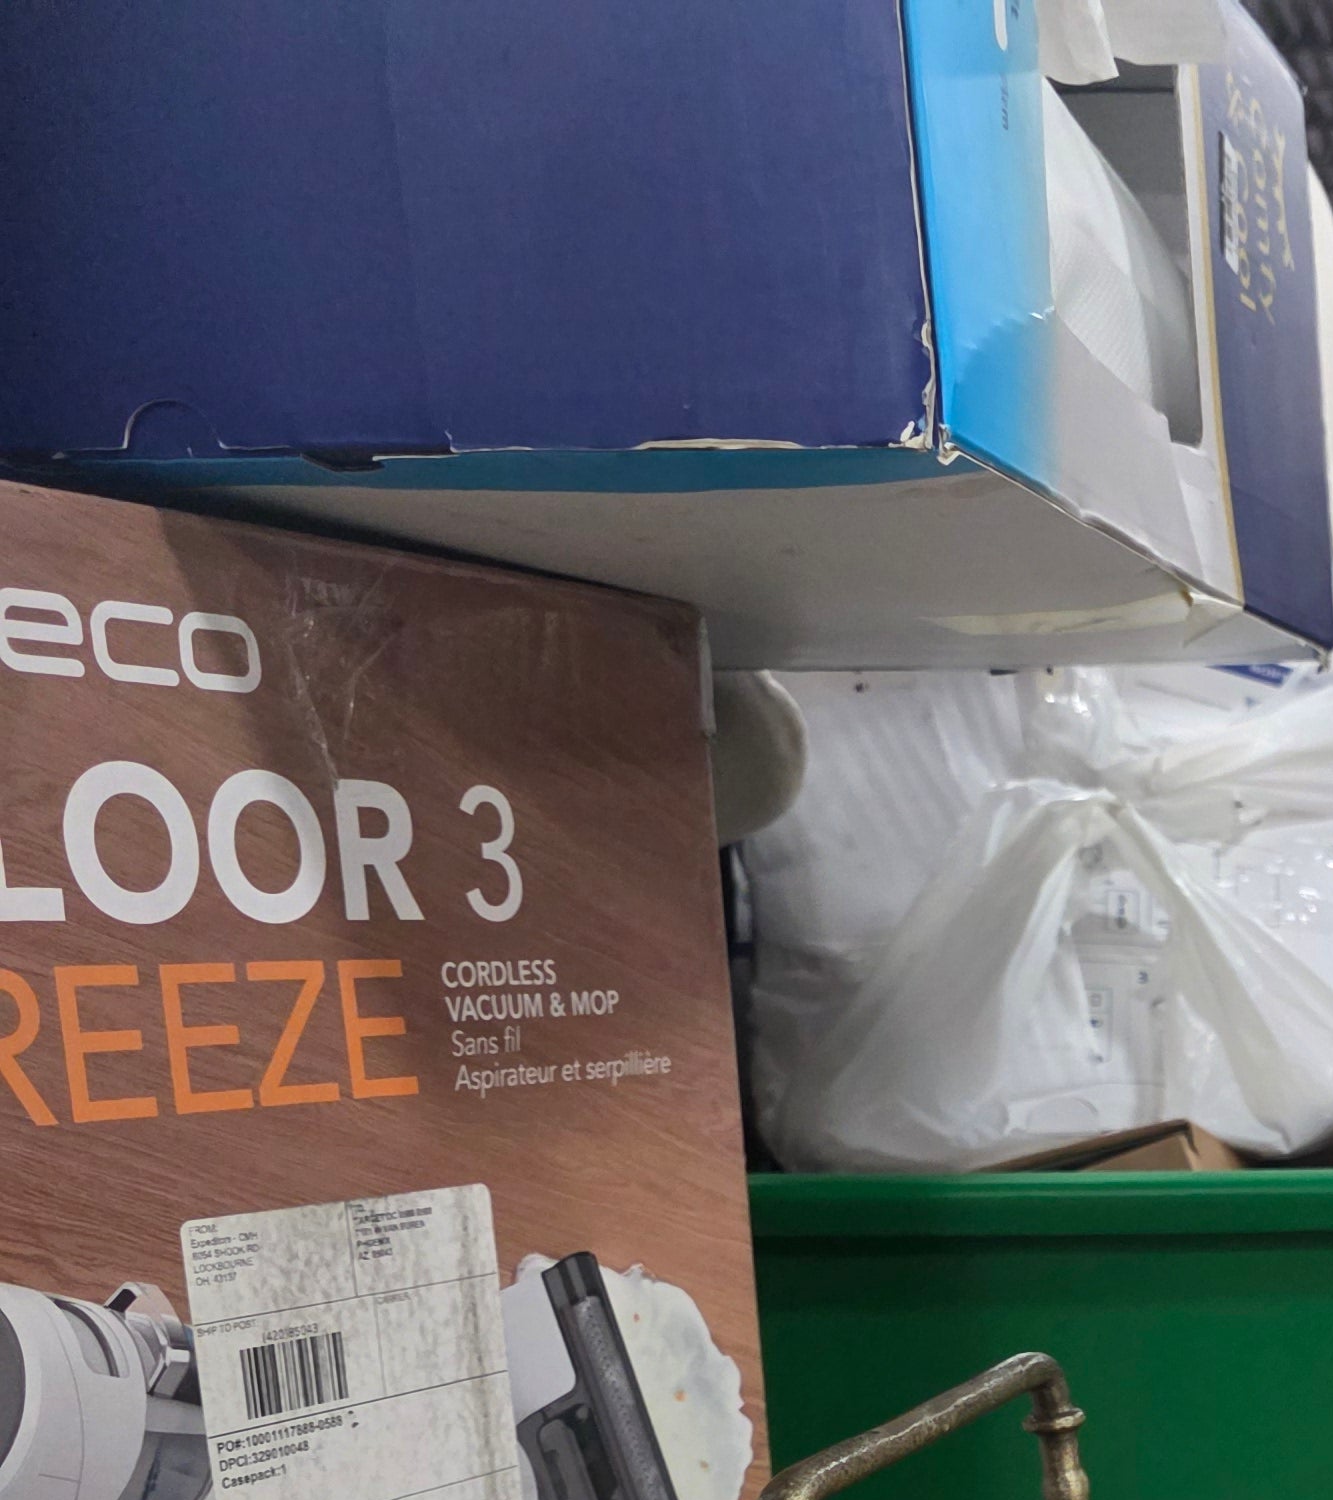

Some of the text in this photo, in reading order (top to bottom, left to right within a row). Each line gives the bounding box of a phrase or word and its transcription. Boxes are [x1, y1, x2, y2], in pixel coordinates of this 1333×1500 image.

[0, 587, 261, 694] eco
[0, 760, 523, 925] LOOR 3
[441, 959, 557, 988] CORDLESS
[444, 990, 619, 1022] VACUUM & MOP
[0, 959, 419, 1126] REEZE
[451, 1026, 521, 1057] Sans fil
[454, 1050, 671, 1099] Aspirateur et serpillière
